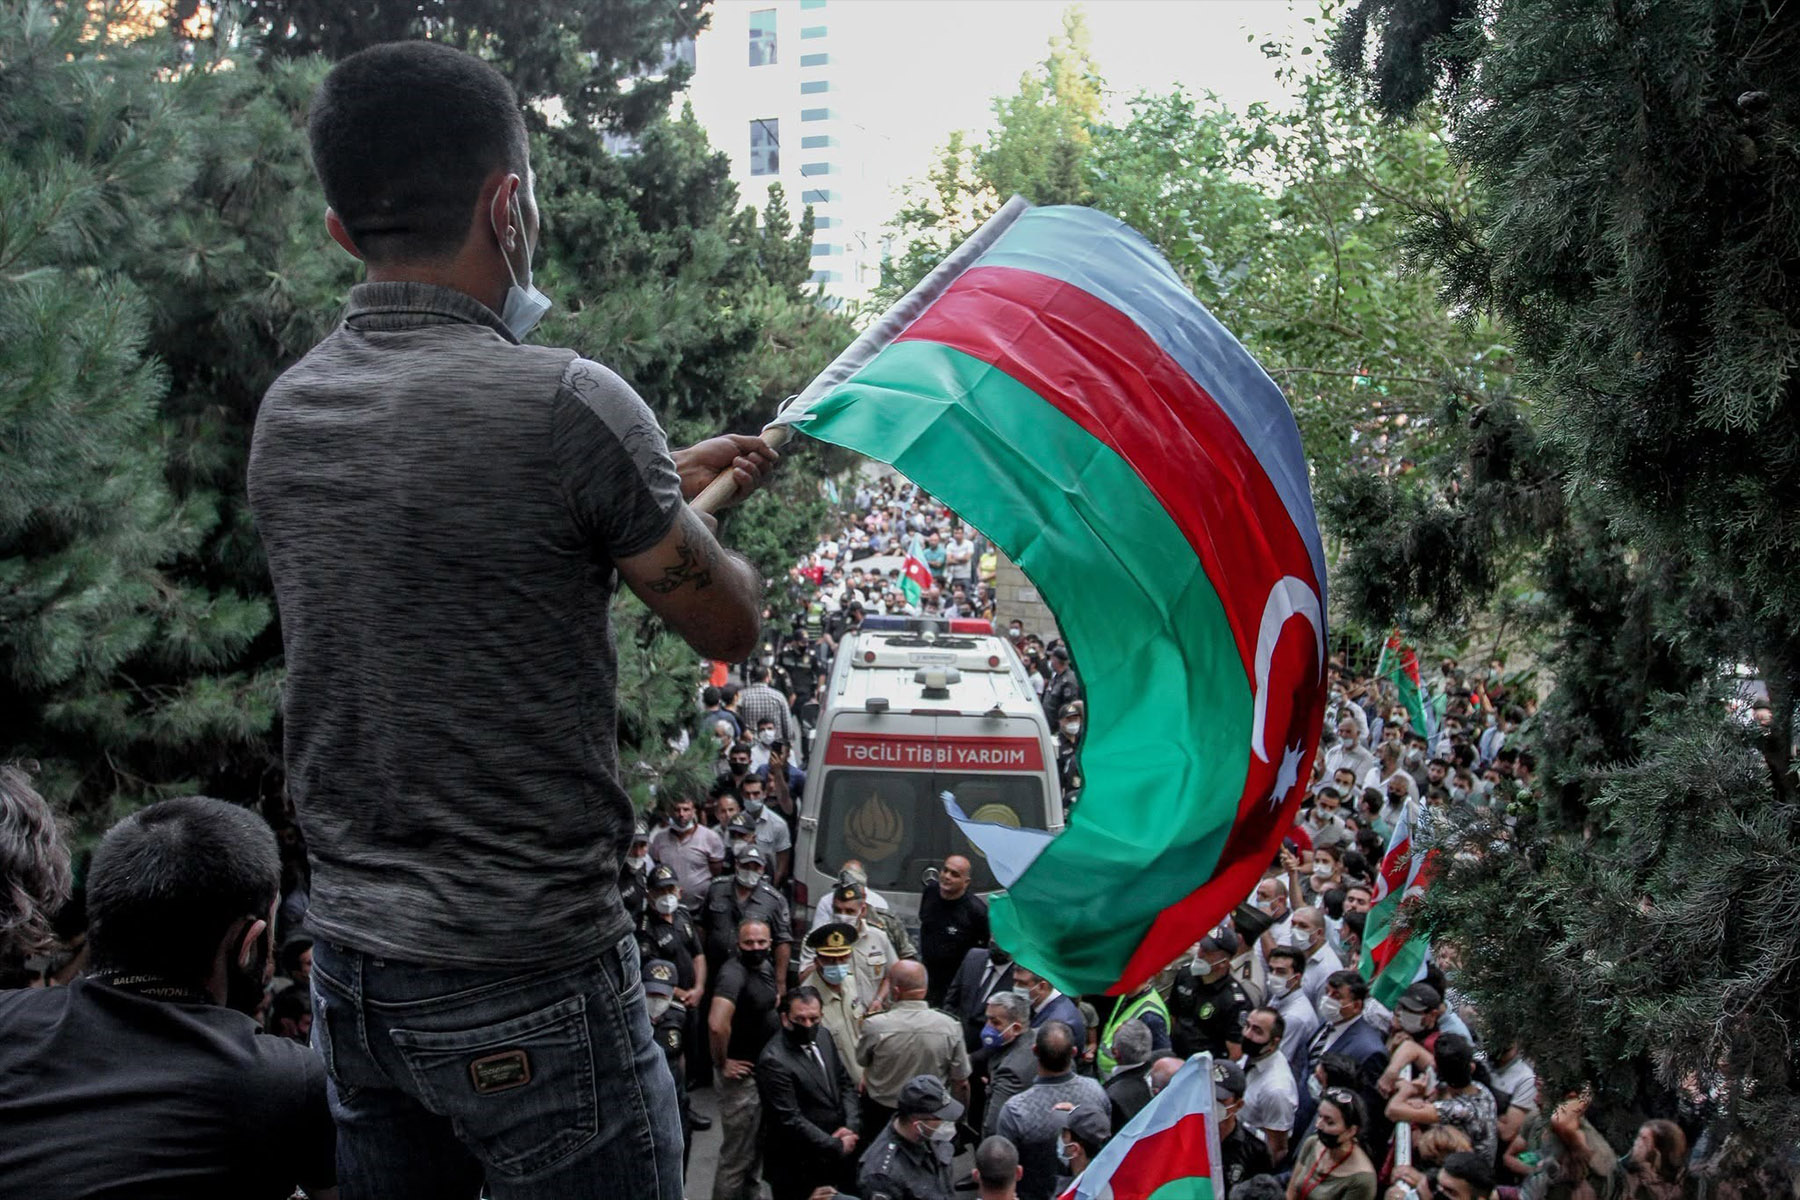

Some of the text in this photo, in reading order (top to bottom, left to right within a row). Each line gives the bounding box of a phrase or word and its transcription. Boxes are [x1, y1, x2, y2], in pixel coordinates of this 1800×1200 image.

[844, 743, 1025, 764] TƏCİLİ TİBBİ YARDIM
